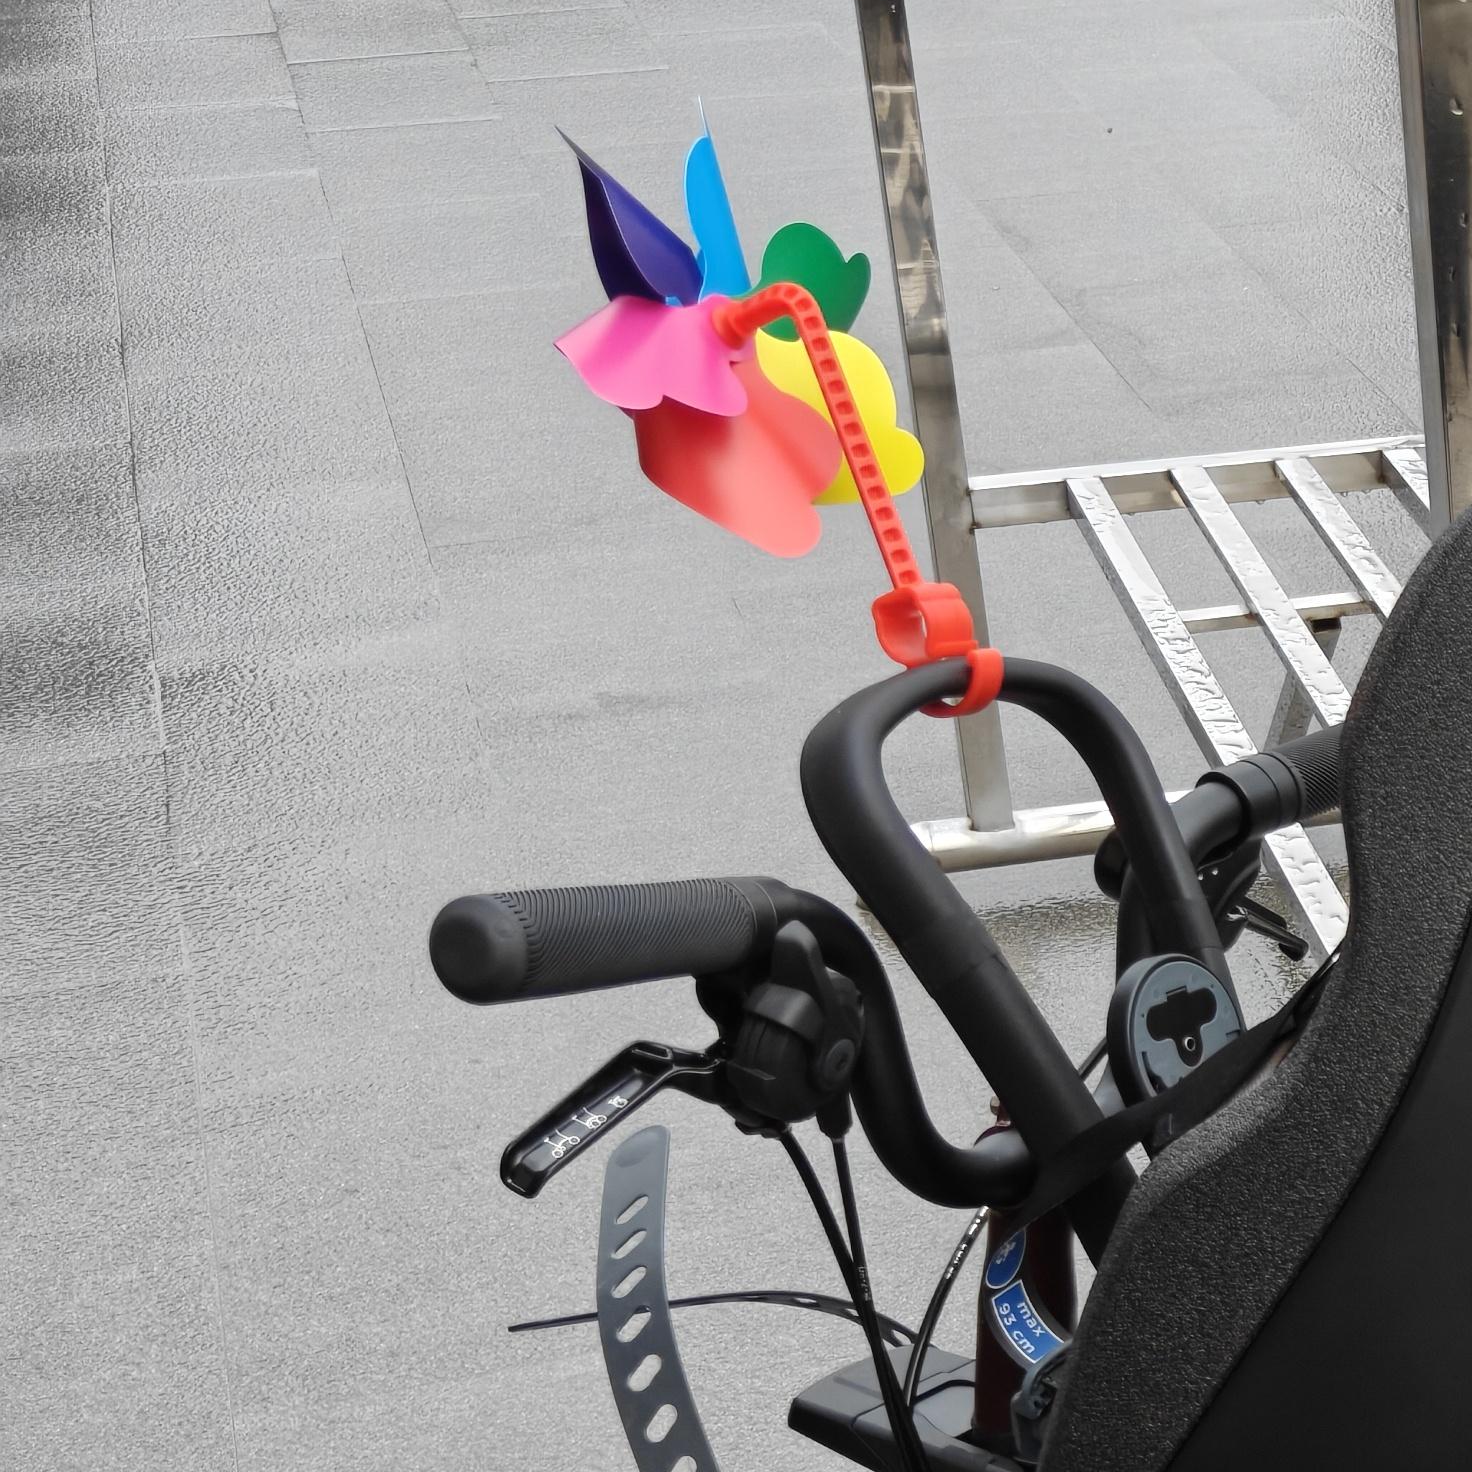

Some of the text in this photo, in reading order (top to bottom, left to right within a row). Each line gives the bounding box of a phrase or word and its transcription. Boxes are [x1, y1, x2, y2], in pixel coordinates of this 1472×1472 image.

[999, 1302, 1036, 1354] 93 cm
[1017, 1302, 1046, 1338] max
